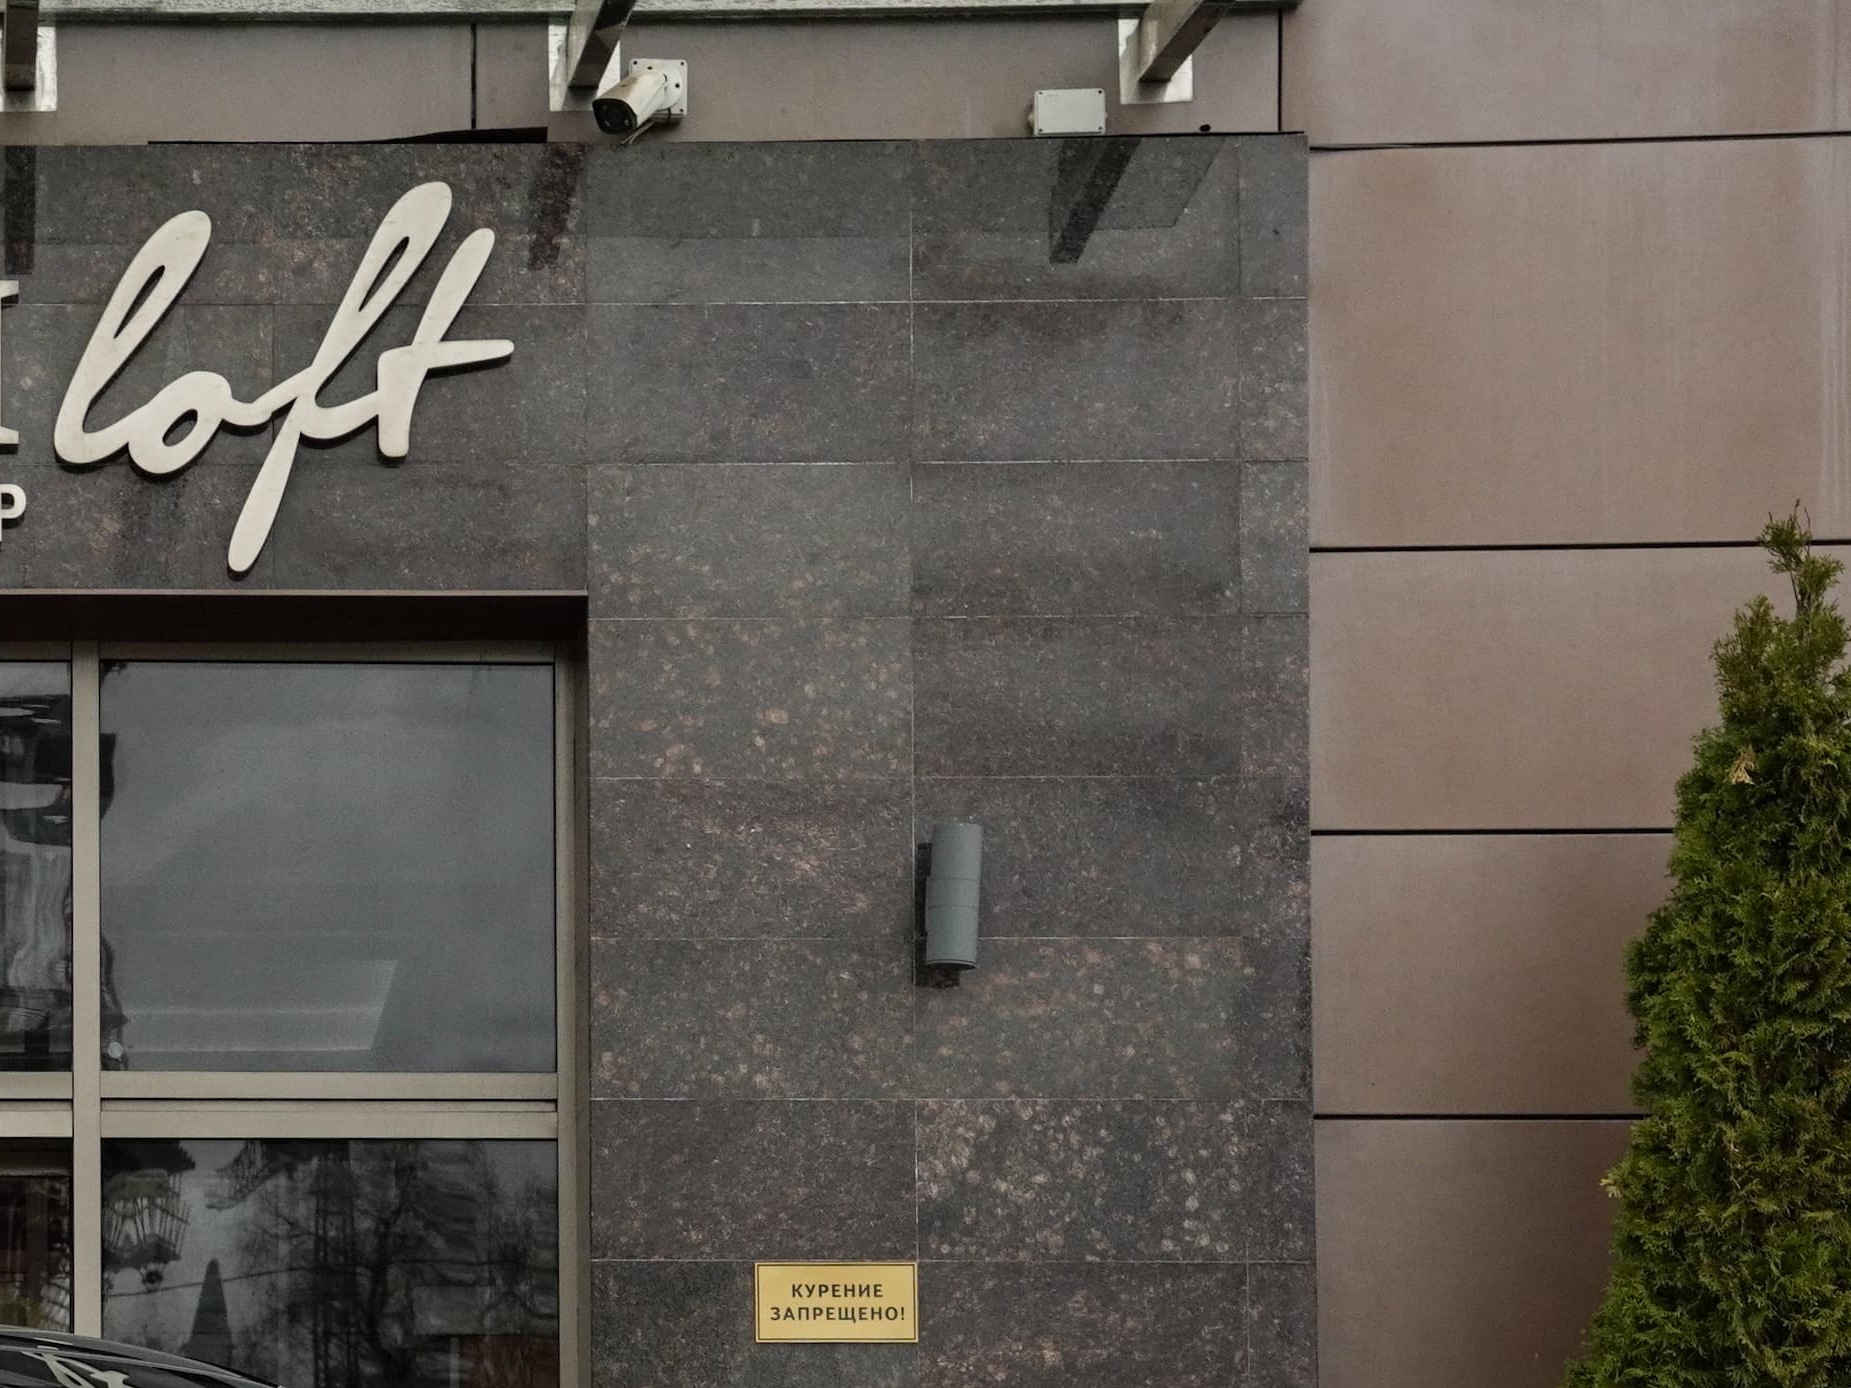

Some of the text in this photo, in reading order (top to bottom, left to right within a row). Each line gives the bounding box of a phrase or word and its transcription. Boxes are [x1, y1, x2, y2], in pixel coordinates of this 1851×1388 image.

[53, 180, 515, 573] loft
[791, 1283, 884, 1298] КУРЕНИЕ
[770, 1306, 906, 1324] ЗАПРЕЩЕНО!
